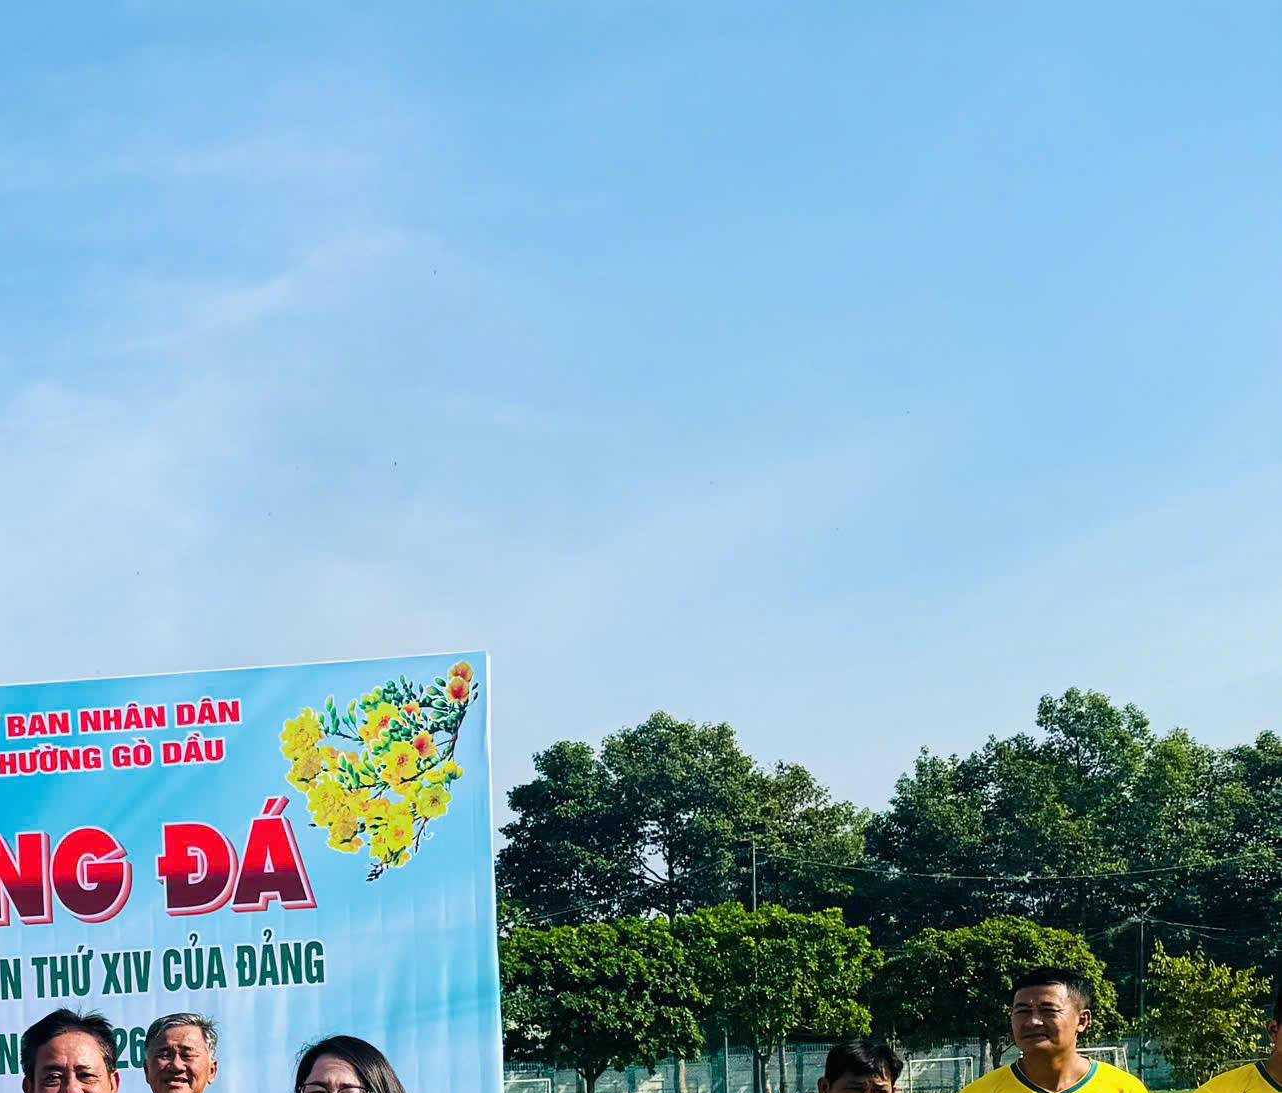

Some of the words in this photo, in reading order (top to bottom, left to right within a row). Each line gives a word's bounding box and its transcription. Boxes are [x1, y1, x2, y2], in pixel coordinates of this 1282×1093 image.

[7, 712, 69, 737] BAN
[80, 703, 166, 733] NHÂN
[176, 697, 240, 726] DÂN
[111, 738, 152, 767] GÒ
[162, 732, 224, 764] DẦU
[156, 796, 317, 915] ĐÁ
[32, 945, 93, 998] THỨ
[102, 950, 152, 995] XIV
[163, 933, 226, 992] CỦA
[236, 929, 325, 987] ĐẢNG
